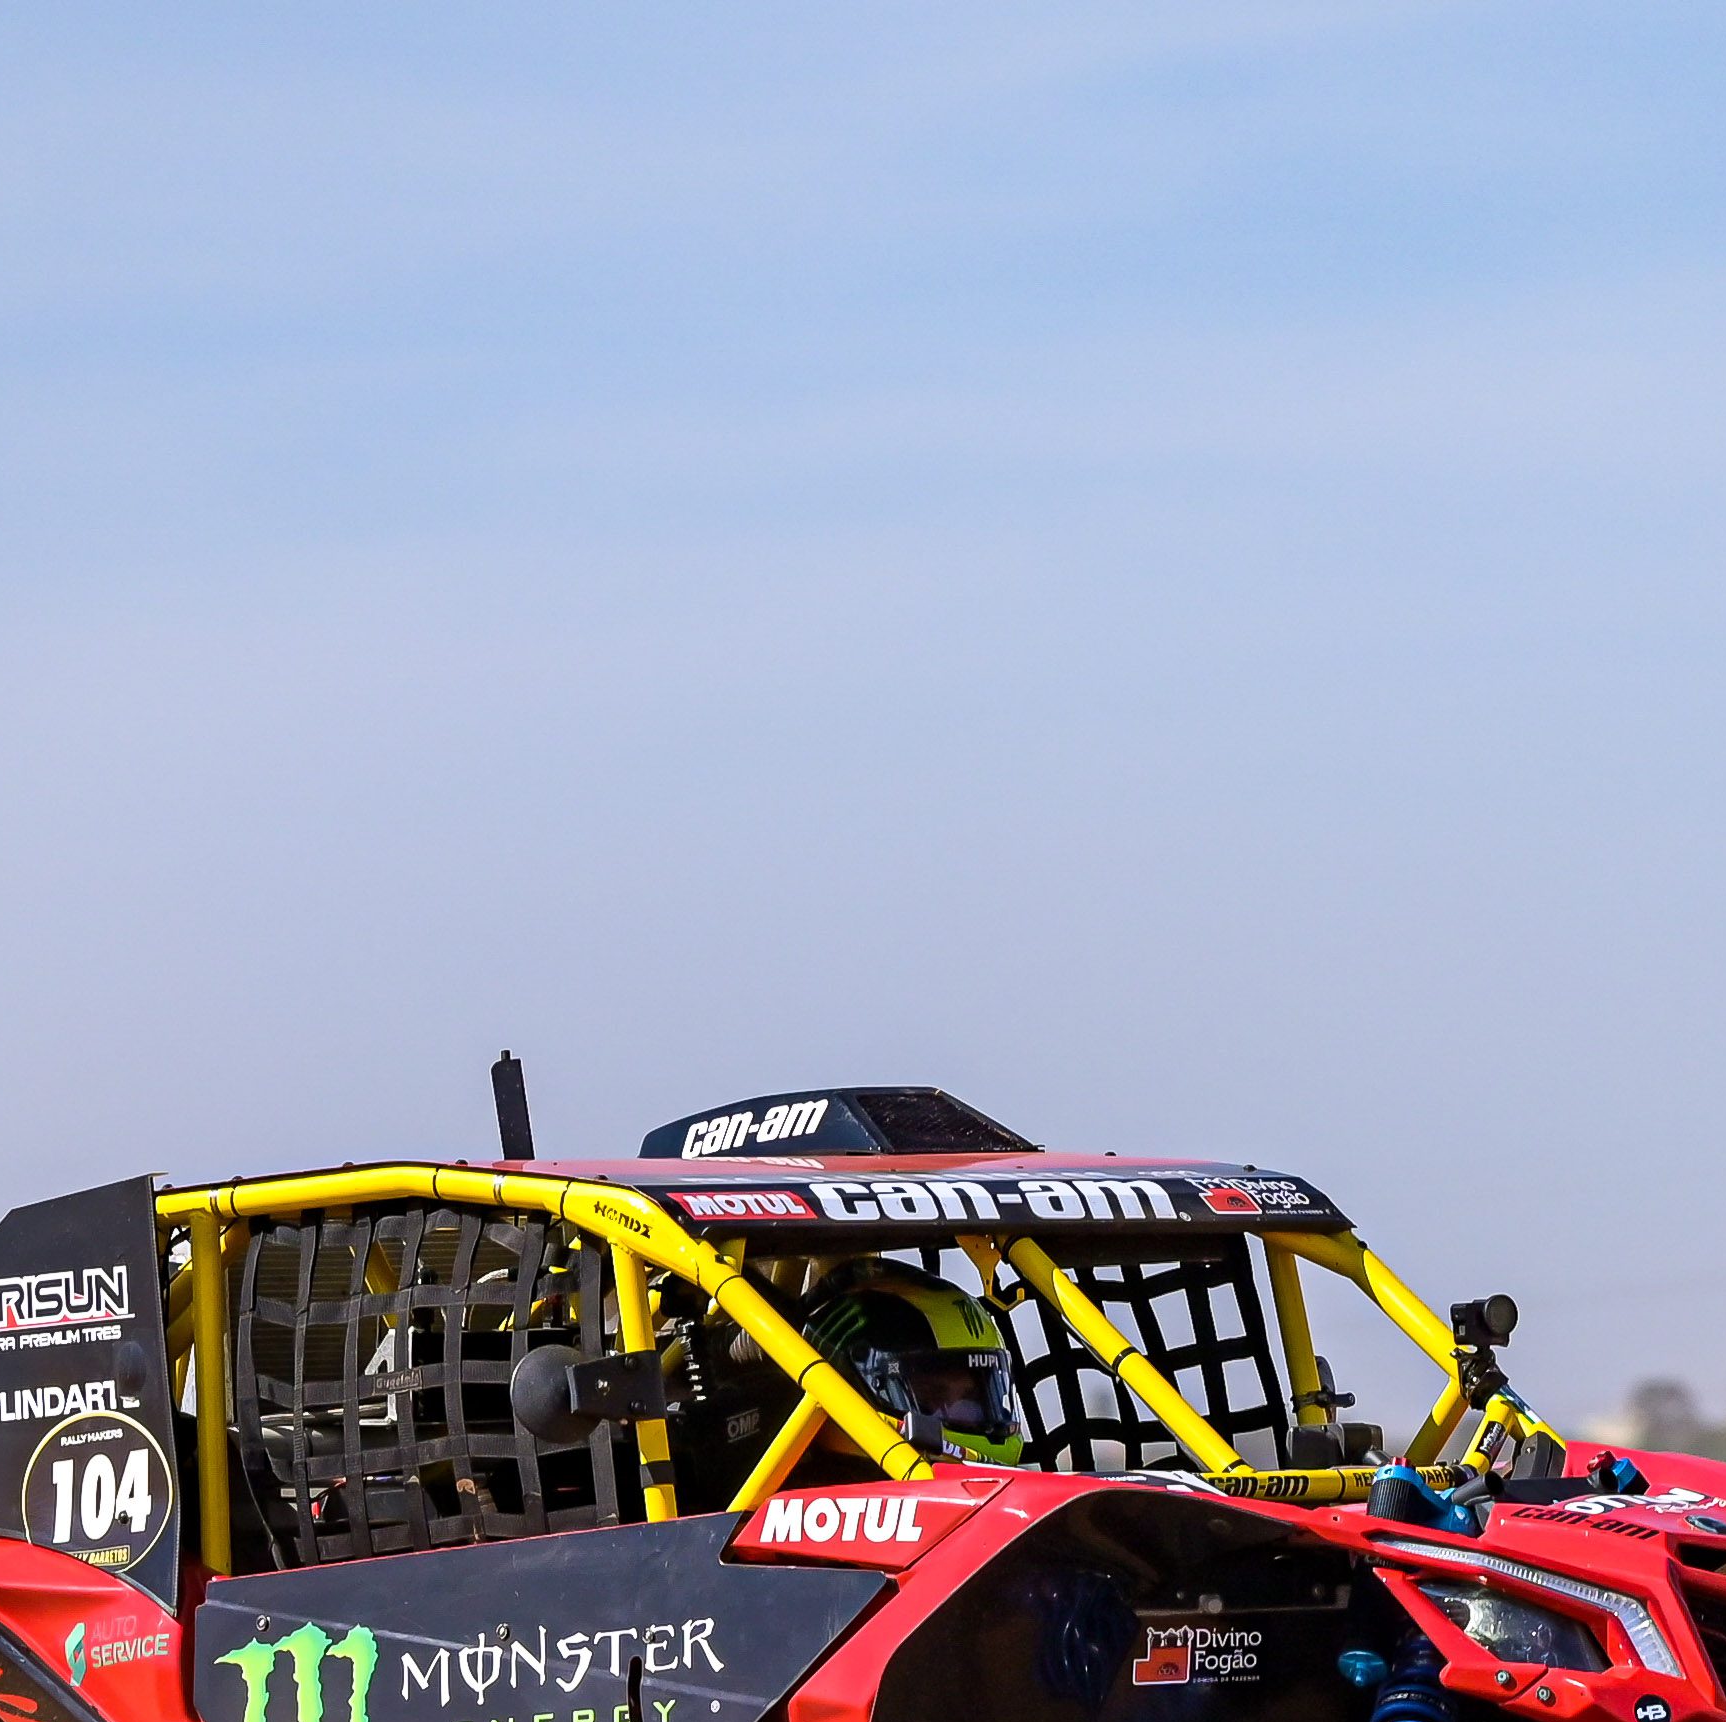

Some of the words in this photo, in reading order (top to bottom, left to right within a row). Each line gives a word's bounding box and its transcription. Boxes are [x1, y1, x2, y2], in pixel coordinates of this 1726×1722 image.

[681, 1099, 829, 1160] can-am
[1232, 1178, 1297, 1190] Divino
[1251, 1190, 1311, 1208] Fogão
[682, 1194, 806, 1216] MOTUL
[808, 1181, 1178, 1221] can-am
[19, 1327, 80, 1349] PREMIUM
[82, 1324, 122, 1343] TIRES
[51, 1448, 152, 1544] 104
[759, 1497, 923, 1543] MOTUL
[1510, 1507, 1660, 1540] can-am
[91, 1615, 137, 1642] AUTO
[1195, 1627, 1262, 1648] Divino
[90, 1633, 170, 1668] SERVICE
[401, 1617, 725, 1708] MONSTER
[1194, 1649, 1257, 1674] Fogão
